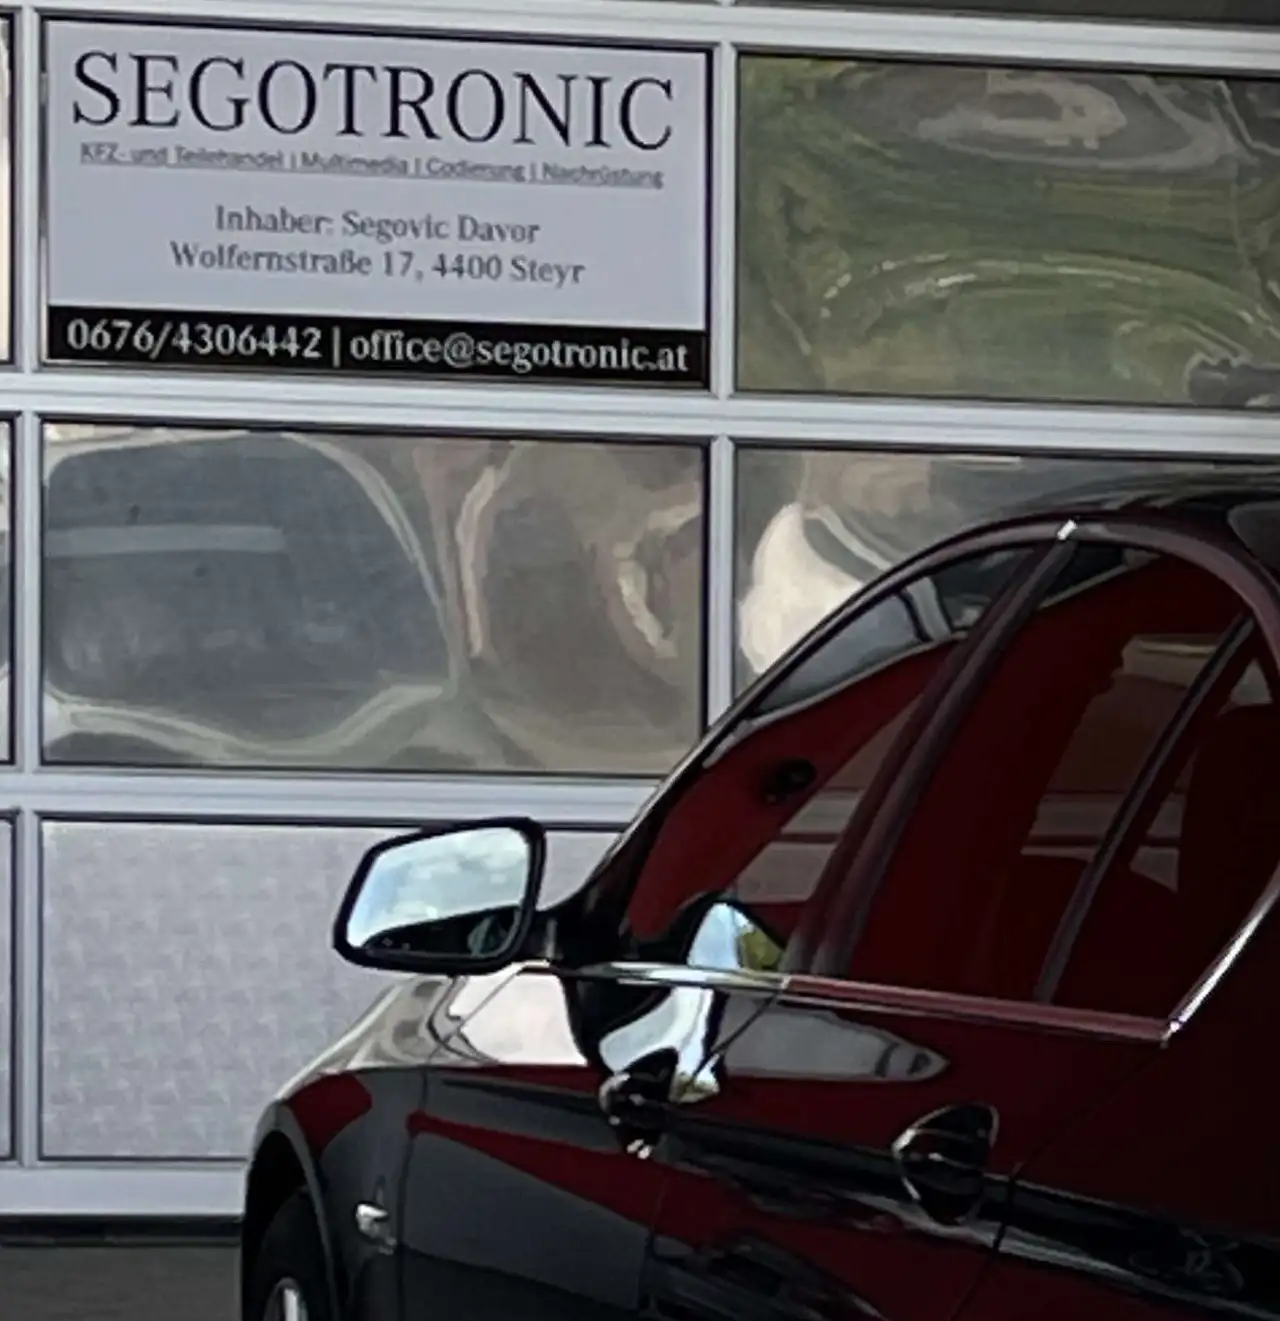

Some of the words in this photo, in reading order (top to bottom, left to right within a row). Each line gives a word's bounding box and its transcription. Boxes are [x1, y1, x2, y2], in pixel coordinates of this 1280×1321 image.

[71, 50, 674, 151] SEGOTRONIC
[215, 203, 334, 235] Inhaber:
[341, 207, 450, 244] Segovic
[457, 208, 541, 244] Davor
[169, 239, 373, 277] Wolfernstraße
[384, 250, 424, 283] 17,
[431, 252, 503, 281] 4400
[510, 254, 587, 290] Steyr
[66, 317, 323, 360] 0676/4306442
[350, 328, 690, 374] office@segotronic.at
